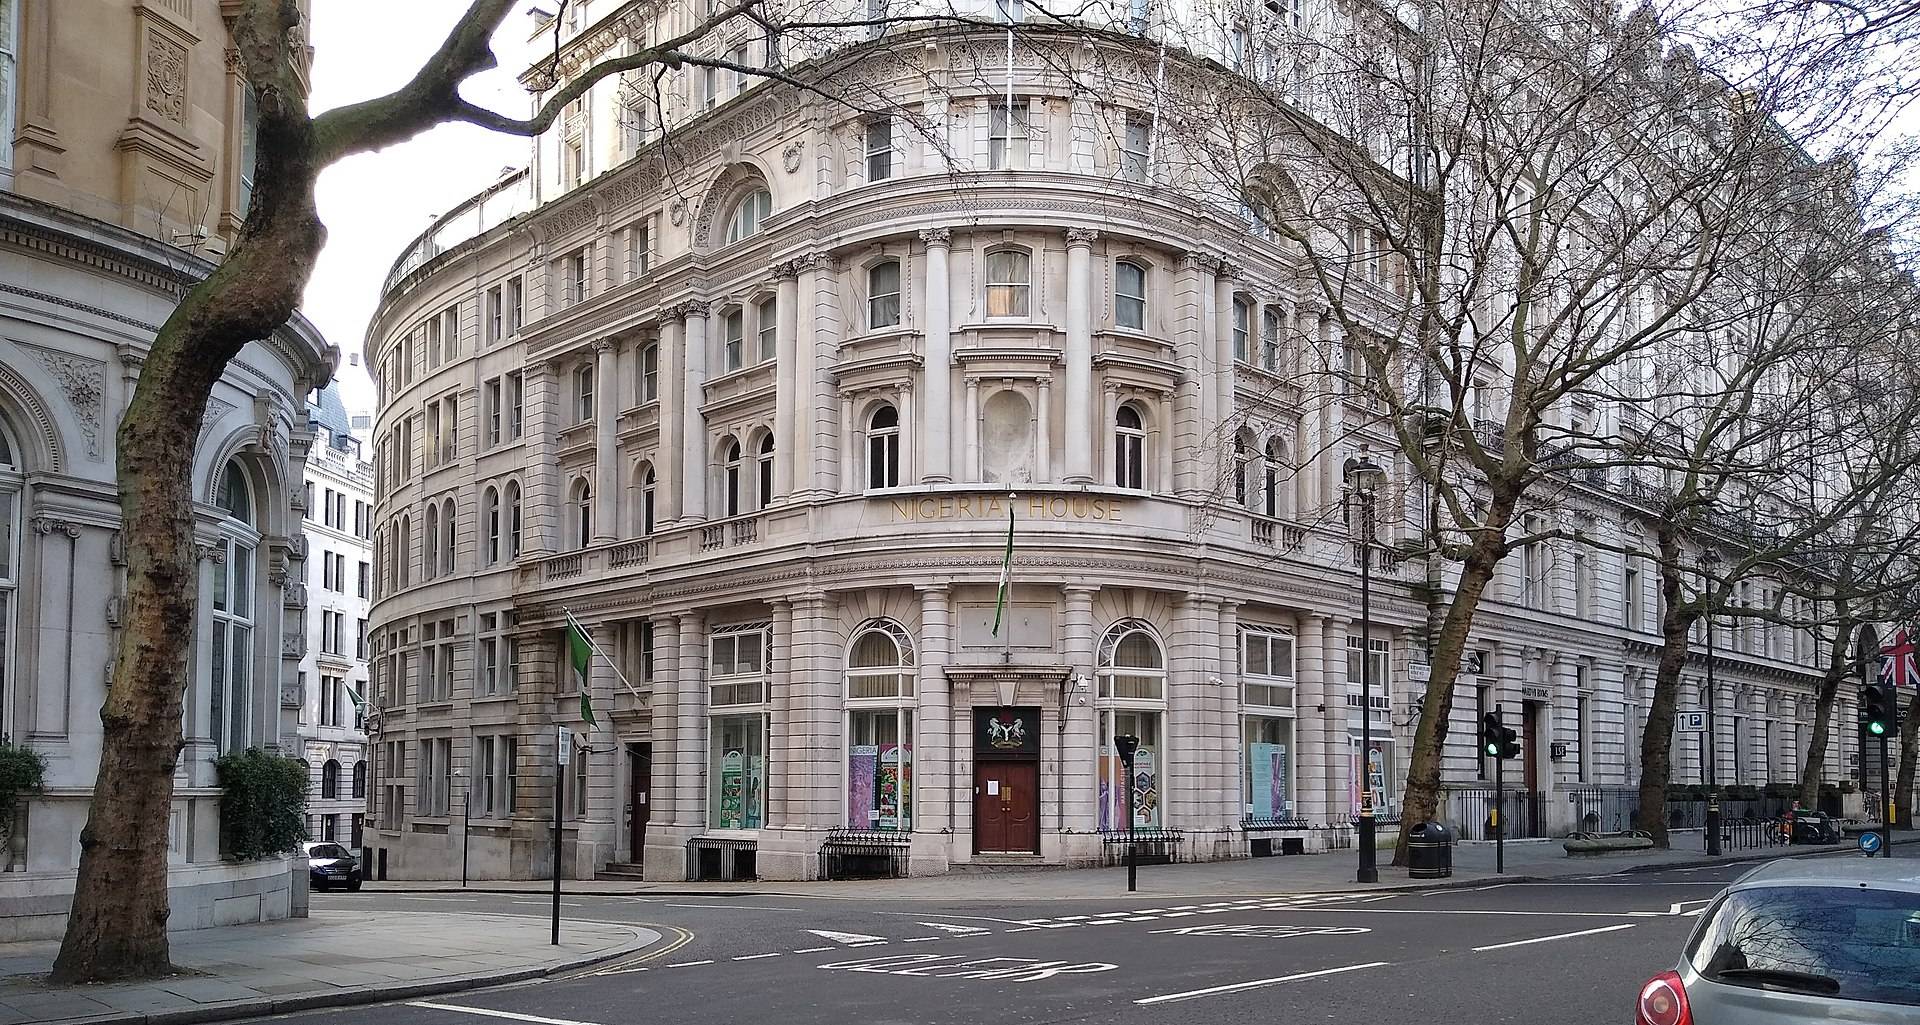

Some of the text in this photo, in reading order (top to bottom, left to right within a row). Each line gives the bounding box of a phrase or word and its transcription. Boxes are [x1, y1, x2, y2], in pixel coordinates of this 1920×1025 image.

[891, 495, 1123, 522] NIGERIA HOUSE
[1691, 715, 1700, 725] P
[850, 746, 877, 755] NIGERIA
[1555, 746, 1565, 756] LSE
